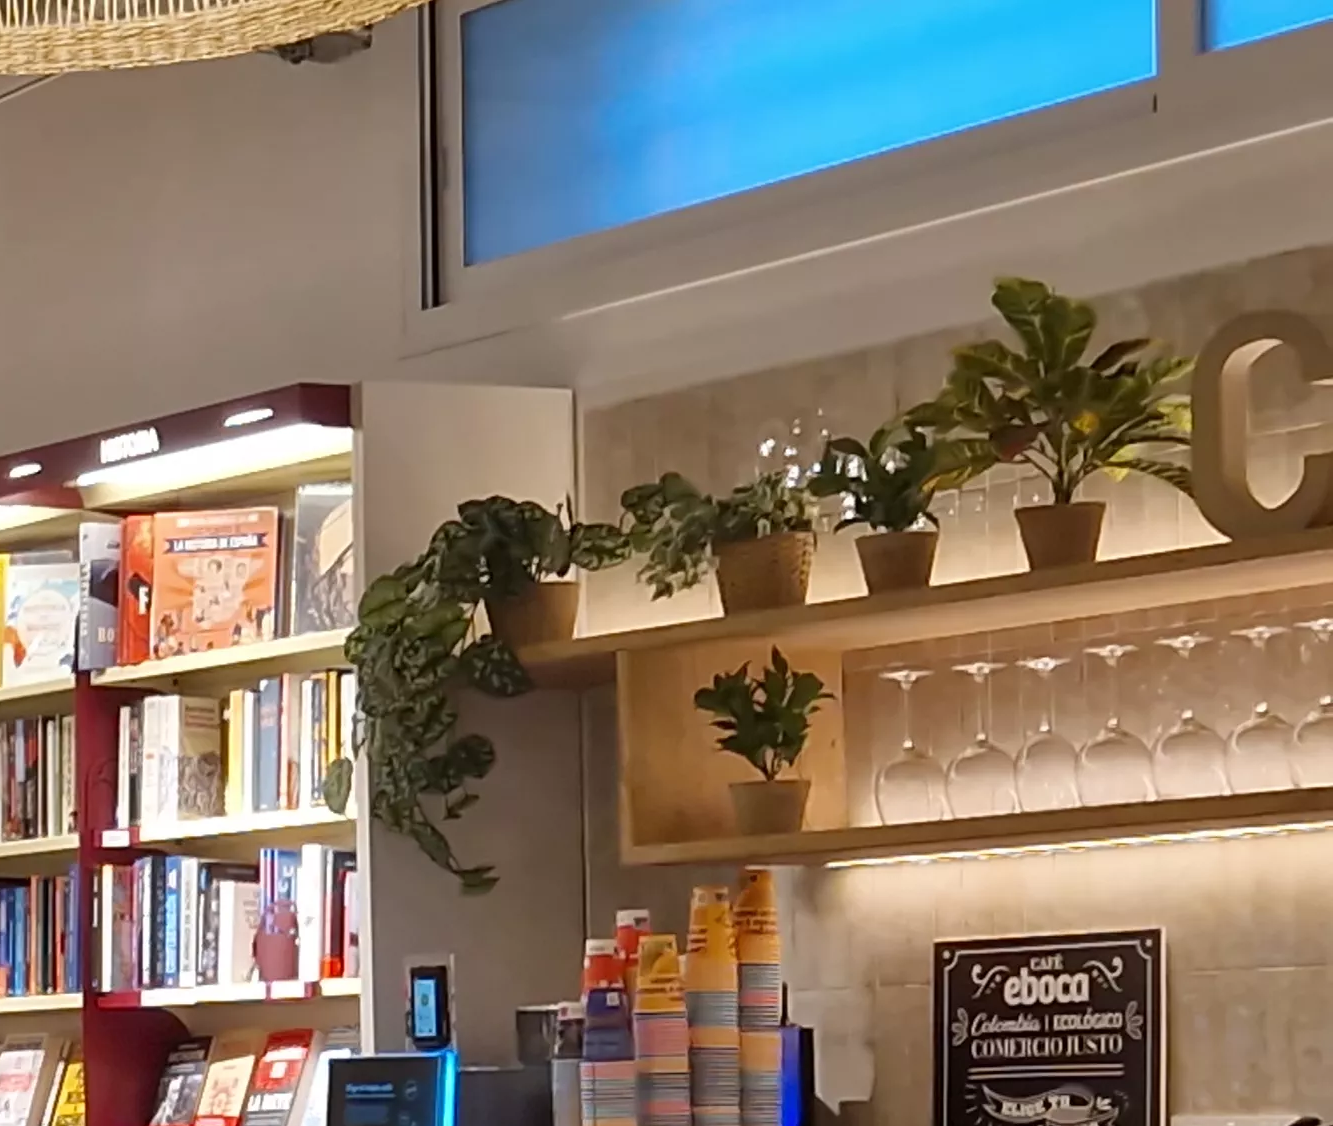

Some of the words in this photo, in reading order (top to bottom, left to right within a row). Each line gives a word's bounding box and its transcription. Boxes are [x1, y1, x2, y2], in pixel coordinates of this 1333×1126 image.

[1030, 953, 1064, 970] CAFÉ
[1003, 967, 1090, 1006] eboca
[971, 1012, 1041, 1036] Colombia
[971, 1037, 1063, 1060] COMERCIO
[1065, 1034, 1123, 1057] JUSTO
